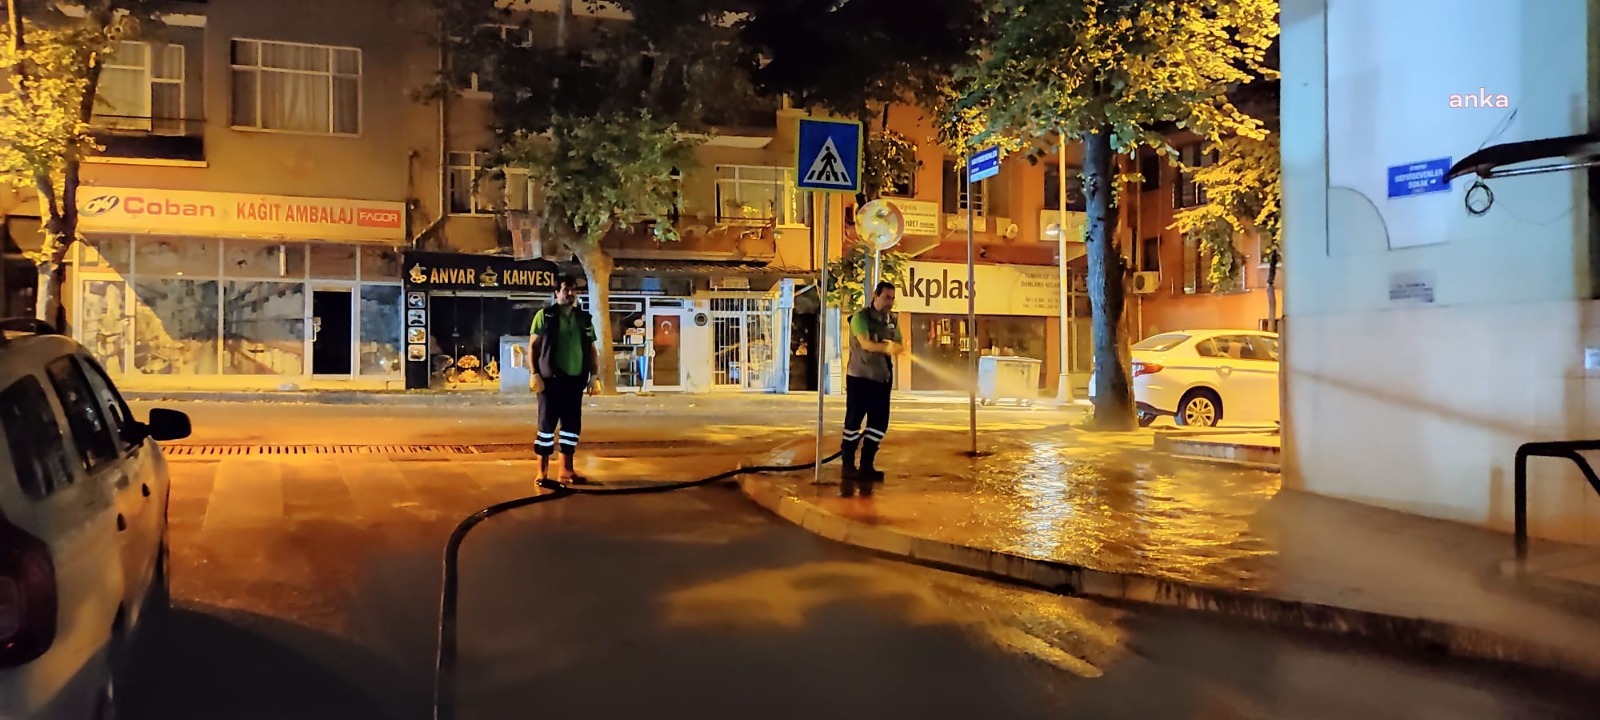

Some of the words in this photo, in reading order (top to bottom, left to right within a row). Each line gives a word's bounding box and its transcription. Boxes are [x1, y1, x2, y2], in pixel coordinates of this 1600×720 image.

[124, 196, 215, 217] Coban
[236, 198, 282, 222] KAĞIT
[285, 204, 354, 225] AMBALAJ
[360, 211, 398, 222] FAGOR
[430, 268, 476, 284] ANVAR
[892, 267, 977, 307] Akplas
